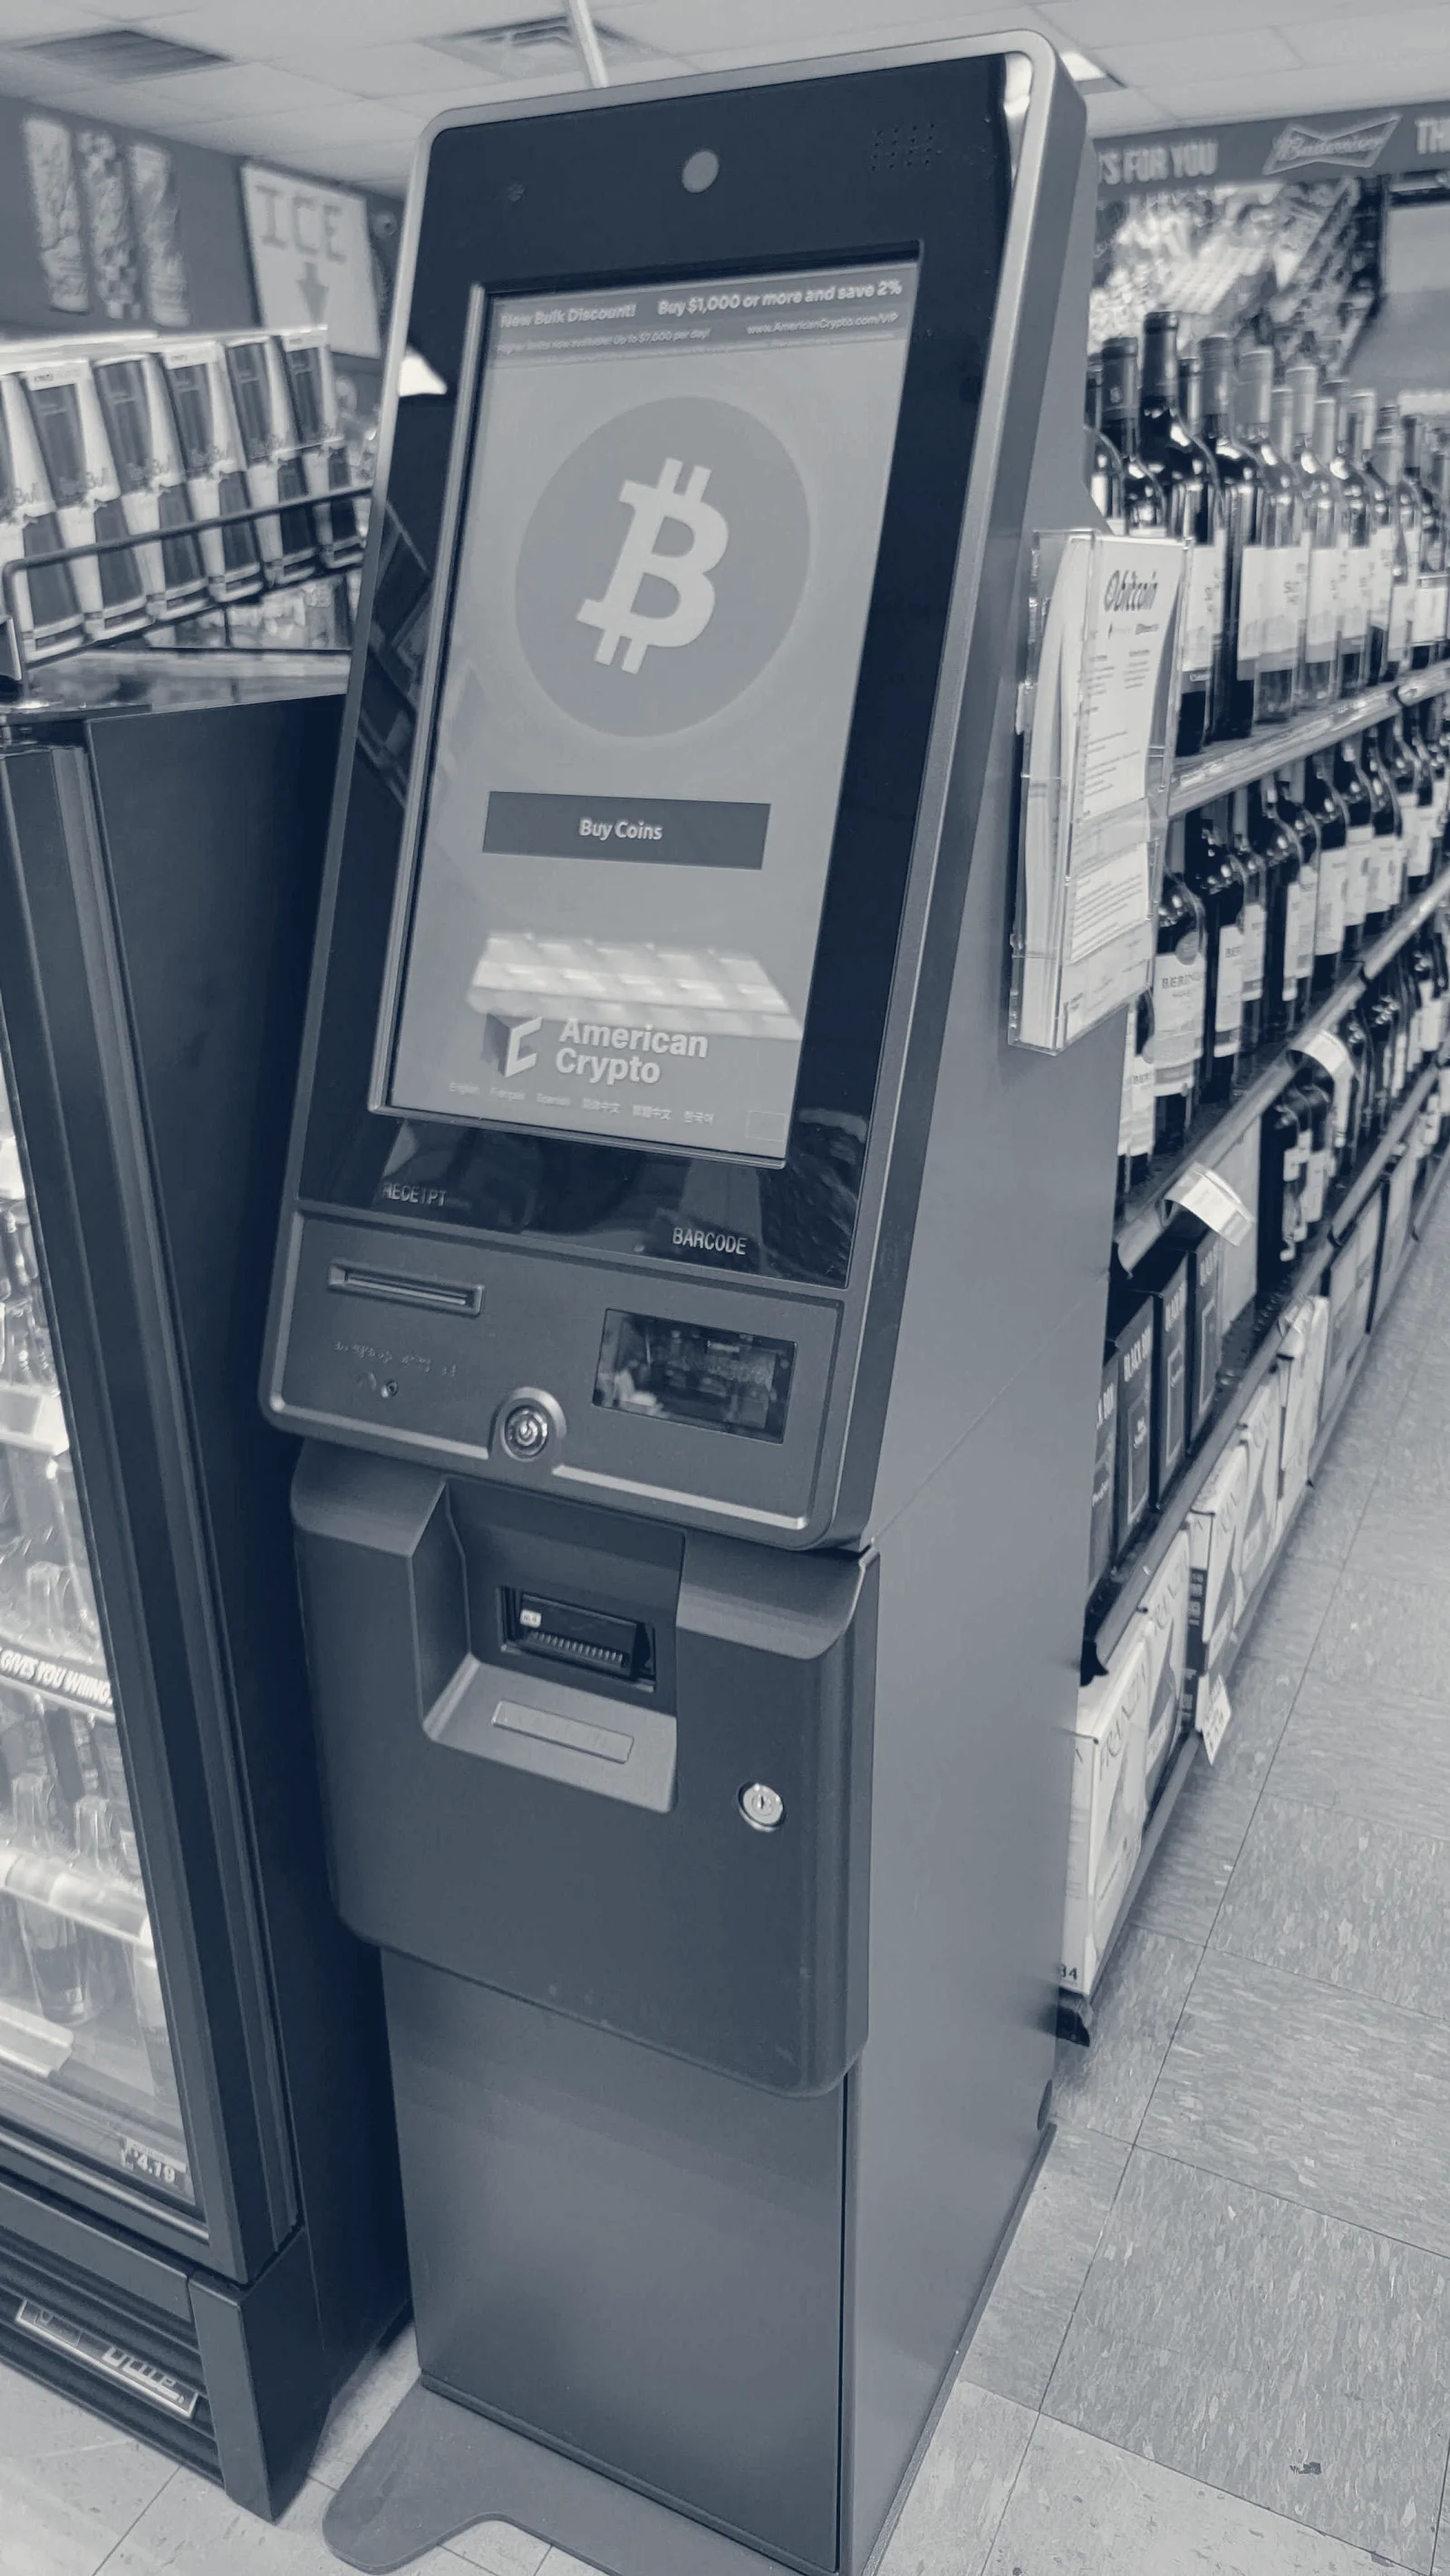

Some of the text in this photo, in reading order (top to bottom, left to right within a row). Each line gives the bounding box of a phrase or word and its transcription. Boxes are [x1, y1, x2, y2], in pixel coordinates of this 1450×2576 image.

[1414, 118, 1450, 154] TH
[1124, 148, 1168, 183] FOR
[1171, 141, 1217, 178] YOU
[255, 184, 348, 265] ICE
[566, 303, 636, 324] Discount!
[658, 298, 686, 317] Buy
[687, 293, 741, 315] $1,000
[742, 295, 760, 308] or
[762, 290, 803, 306] more
[805, 286, 836, 303] and
[837, 283, 875, 300] save
[877, 278, 904, 297] 2%
[579, 818, 663, 841] Buy Coins
[558, 1017, 710, 1059] American
[555, 1046, 662, 1086] Crypto
[382, 1181, 448, 1207] RECEIPT
[672, 1226, 748, 1255] BARCODE
[36, 1661, 69, 1689] YOU
